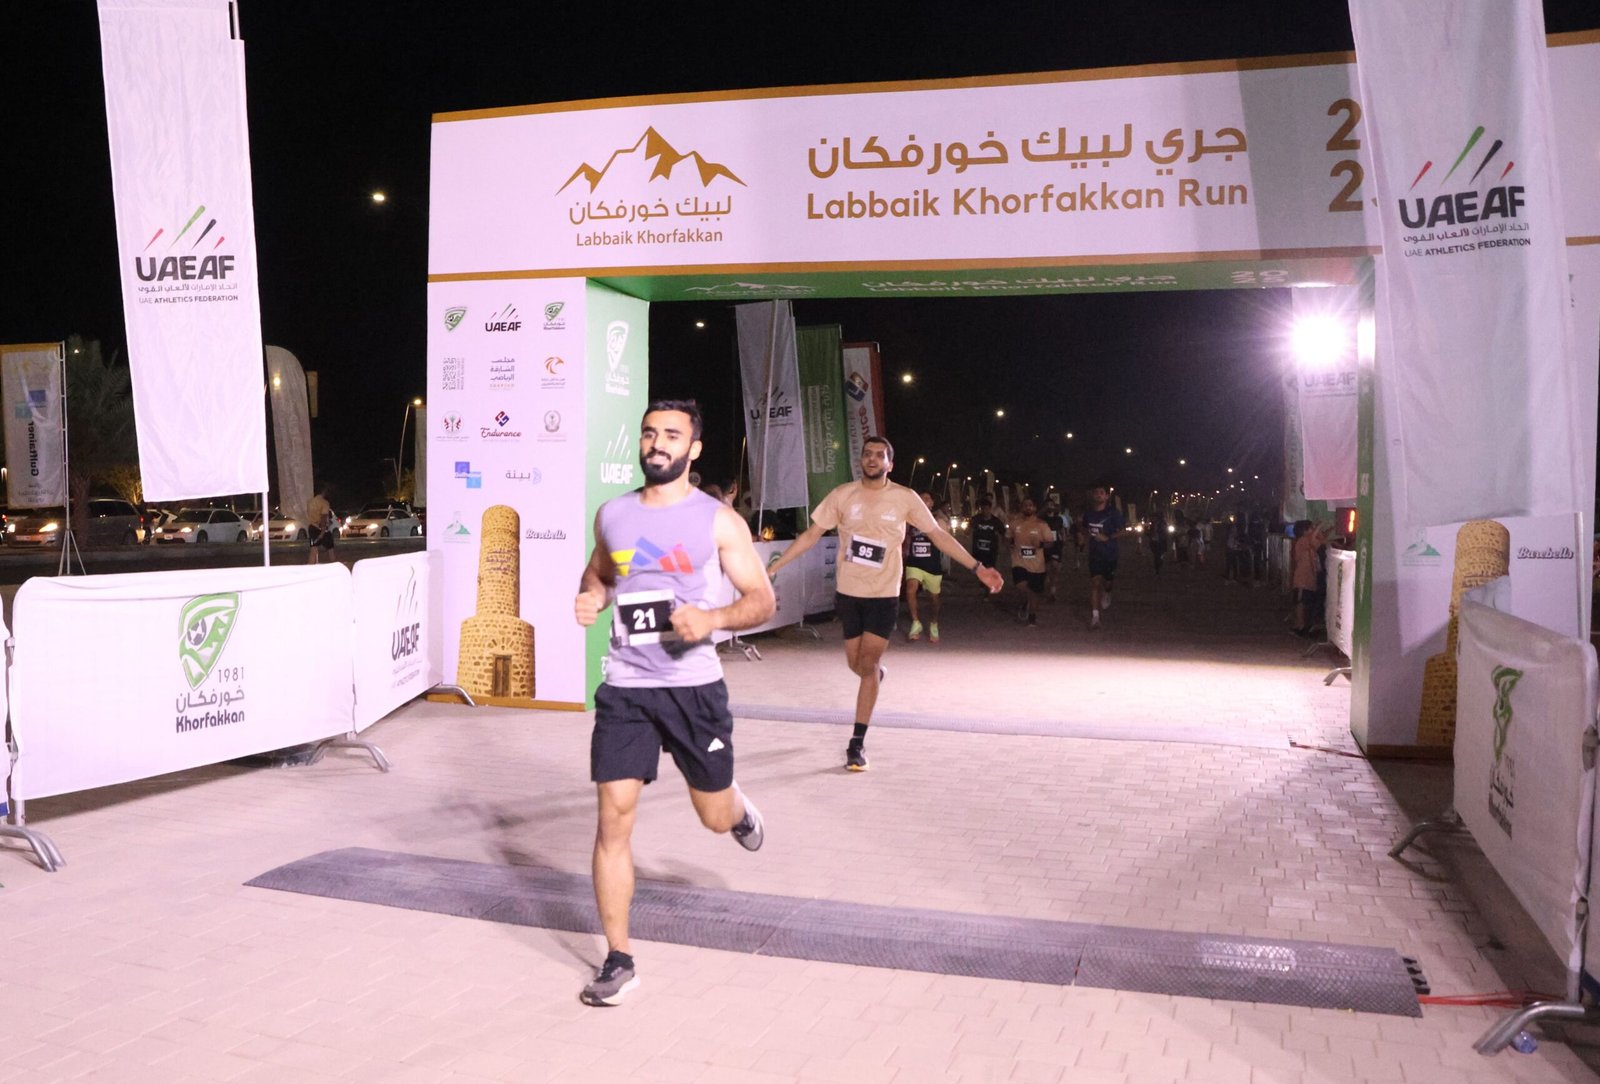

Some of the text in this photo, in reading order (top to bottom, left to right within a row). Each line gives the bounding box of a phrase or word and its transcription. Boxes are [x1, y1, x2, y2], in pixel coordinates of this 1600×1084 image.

[1326, 98, 1363, 152] 2
[807, 124, 1248, 180] جري لبيك خورفكان
[1328, 159, 1379, 212] 2
[569, 195, 732, 226] لبيك خورفكان
[806, 178, 1248, 220] Labbaik Khorfakkan Run
[1398, 185, 1525, 229] UAEAF
[576, 228, 723, 247] Labbaik Khorfakkan
[1404, 238, 1532, 258] UAE ATHLETICS FEDERATION
[135, 255, 235, 281] UAEAF
[154, 296, 193, 304] ATHLETICS
[194, 295, 239, 303] FEDERATION
[485, 321, 522, 332] UAEAF
[1304, 372, 1356, 387] UAEAF
[750, 406, 792, 420] UEAF
[480, 427, 522, 439] Endurance
[600, 462, 633, 484] UAEAF
[858, 545, 873, 558] 95
[1517, 546, 1575, 559] Barebells
[632, 607, 657, 631] 21
[391, 622, 420, 661] UAEAF
[218, 667, 244, 683] 1981
[176, 685, 245, 714] خورفكان
[176, 709, 245, 734] Khorfakkan
